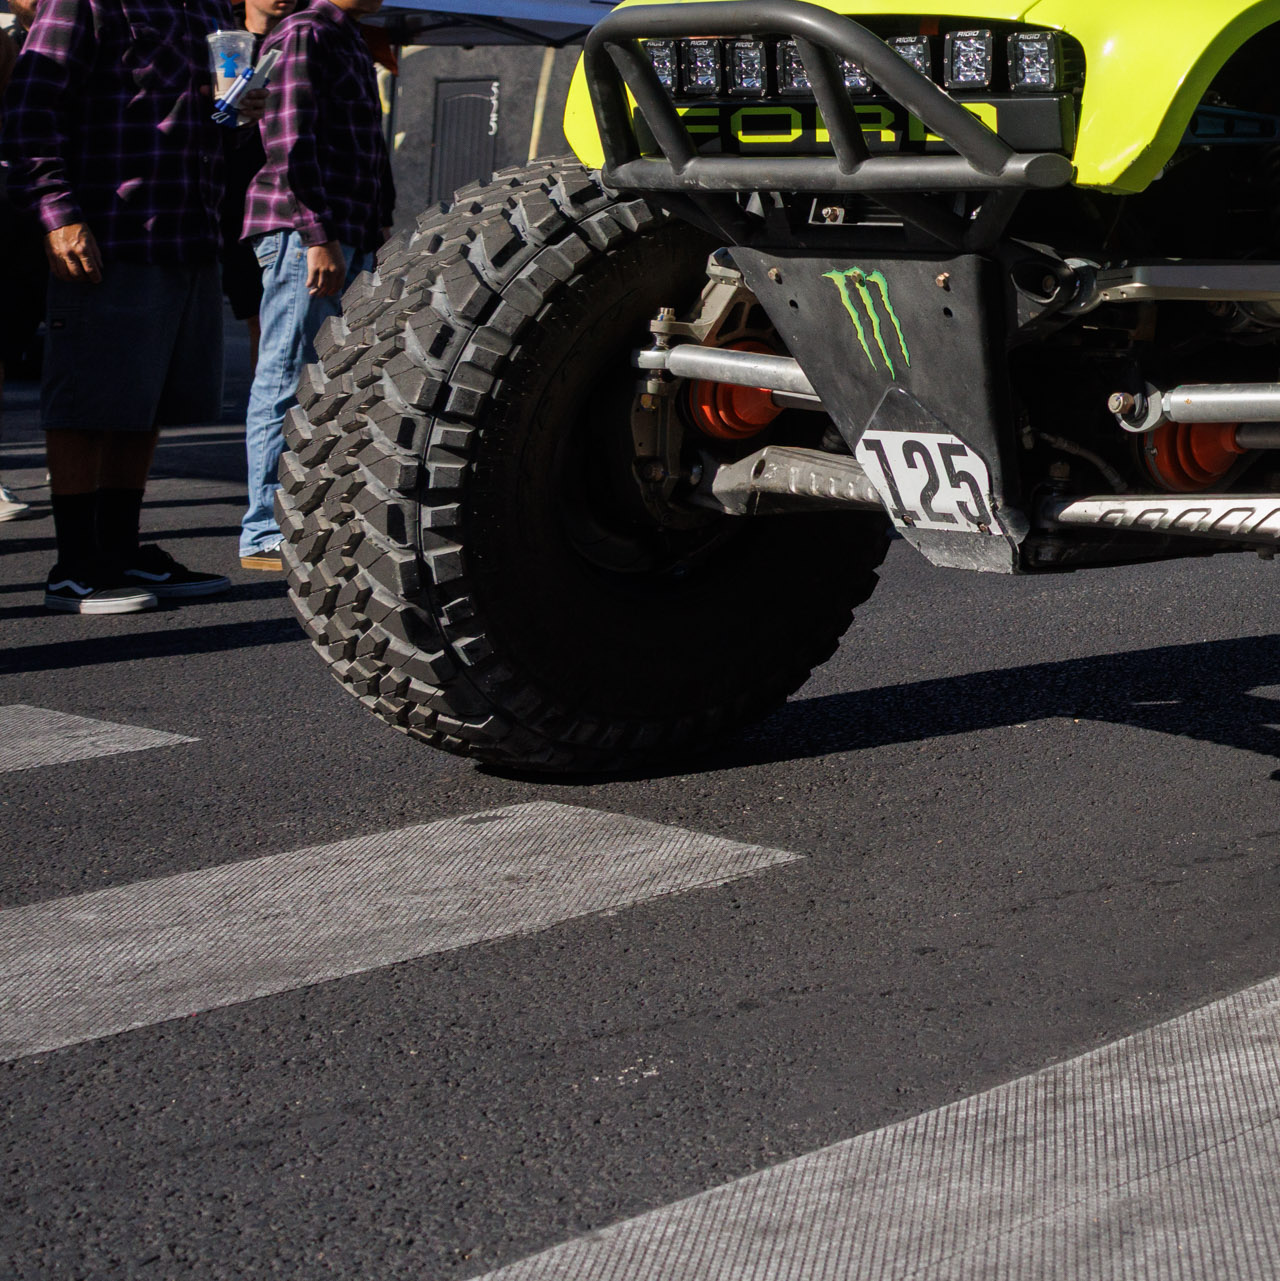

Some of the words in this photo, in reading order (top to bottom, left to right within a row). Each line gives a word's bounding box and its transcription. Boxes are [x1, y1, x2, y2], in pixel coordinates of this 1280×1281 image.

[957, 29, 981, 39] RIGID
[1018, 31, 1041, 40] RIGID
[862, 438, 992, 527] 125
